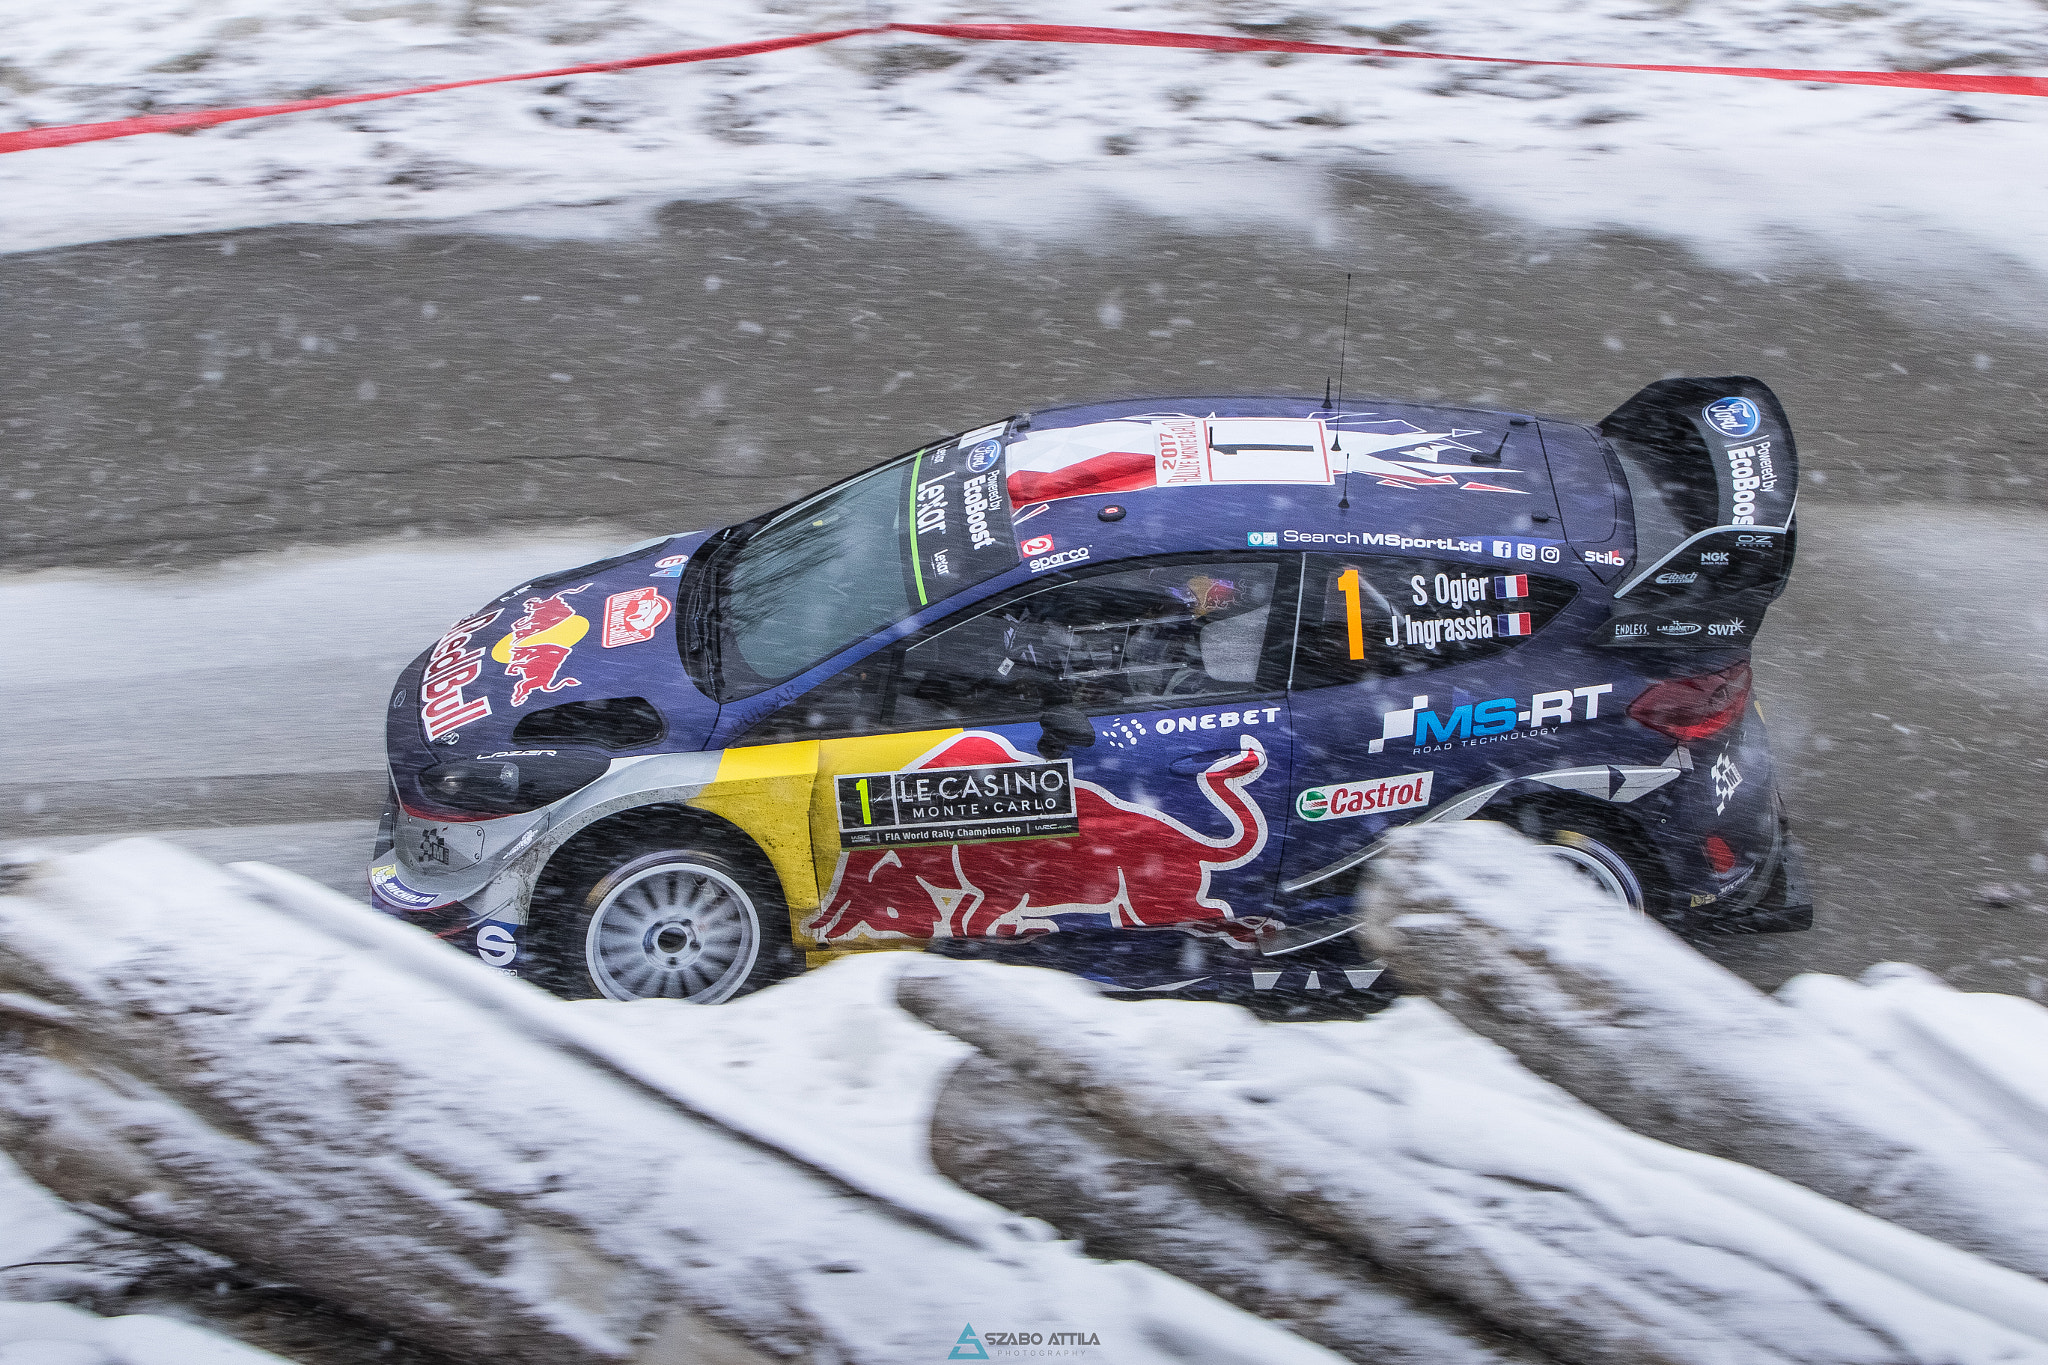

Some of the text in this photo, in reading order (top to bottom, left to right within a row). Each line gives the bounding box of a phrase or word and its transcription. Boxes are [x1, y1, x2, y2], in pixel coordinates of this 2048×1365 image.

[1160, 433, 1177, 470] 2017
[1213, 443, 1314, 455] 1
[1167, 461, 1201, 483] RALLYE
[1756, 441, 1778, 492] Powered by
[987, 469, 1002, 500] Powered
[1727, 446, 1760, 525] EcoBoos
[917, 471, 956, 535] Lexar
[963, 474, 996, 550] EcoBoost
[1283, 529, 1482, 554] Search MSportLtd
[934, 549, 949, 576] Lexar
[1584, 550, 1625, 567] Stilo
[1701, 552, 1730, 561] NGK
[1411, 570, 1489, 610] S Ogier
[1655, 572, 1698, 584] Eibach
[1337, 569, 1365, 661] 1
[1708, 623, 1739, 636] SWP
[1385, 610, 1493, 650] J Ingrassia
[1615, 624, 1648, 636] ENDLESS
[1155, 707, 1281, 735] ONEBET
[1414, 683, 1613, 747] MS-RT
[1413, 726, 1559, 755] ROAD TECHNOLOGY
[900, 769, 1064, 803] LE CASINO
[1331, 778, 1423, 815] Castrol
[856, 778, 872, 825] 1
[912, 798, 1057, 819] MONTE CARLO
[885, 825, 1021, 841] FIA World Rally Championship
[383, 883, 436, 903] MICHELIN
